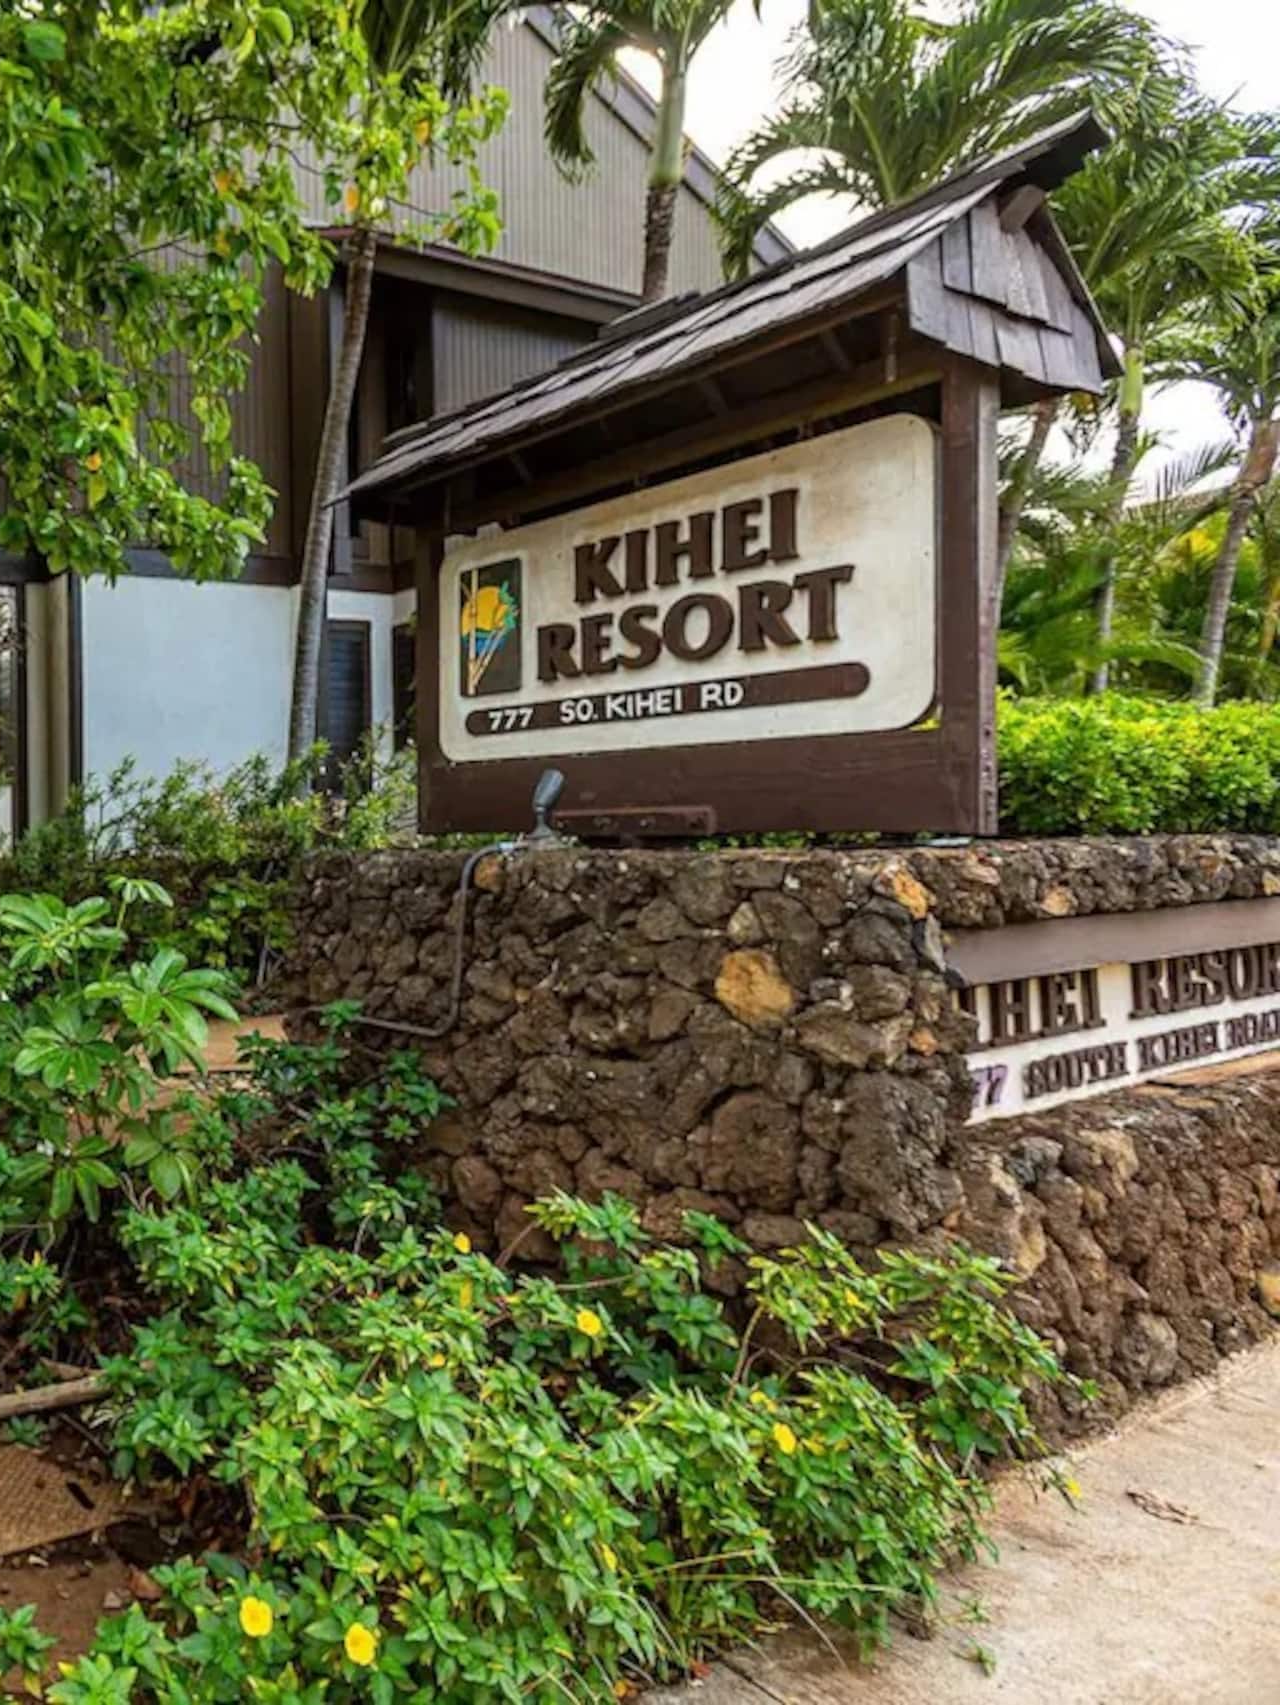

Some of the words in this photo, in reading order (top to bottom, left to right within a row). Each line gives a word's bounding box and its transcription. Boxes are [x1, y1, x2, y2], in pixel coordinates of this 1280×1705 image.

[574, 488, 799, 602] KIHEI
[536, 565, 855, 682] RESORT
[488, 707, 534, 731] 777
[560, 699, 599, 724] SO.
[605, 688, 683, 720] KIHEI
[700, 682, 745, 709] RD
[958, 968, 1108, 1053] IHEI
[1128, 943, 1280, 1019] RESOR
[969, 1064, 1009, 1108] 77
[1023, 1042, 1129, 1099] SOUTH
[1137, 1020, 1222, 1074] KIHEI
[1224, 1009, 1280, 1052] ROA
